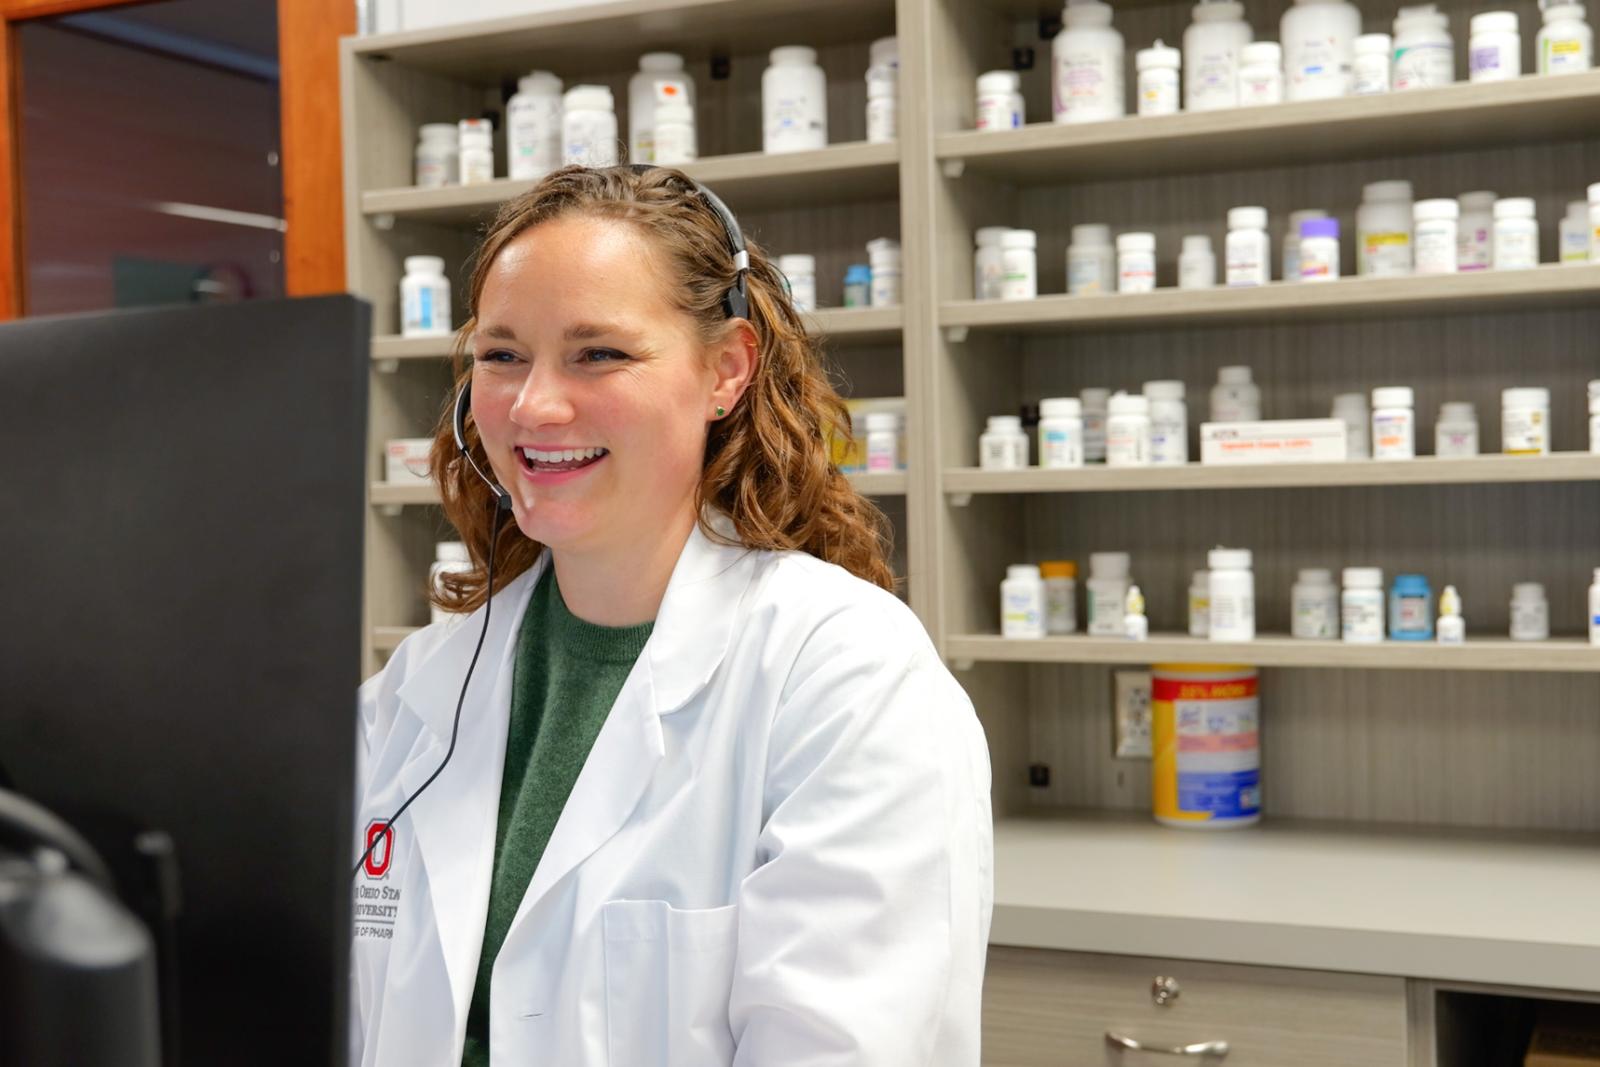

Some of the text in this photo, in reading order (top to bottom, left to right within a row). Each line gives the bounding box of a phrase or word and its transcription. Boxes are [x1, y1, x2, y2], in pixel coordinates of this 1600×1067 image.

[363, 818, 395, 880] O
[360, 884, 380, 899] OHIO
[381, 885, 401, 900] STA
[360, 926, 369, 936] OF
